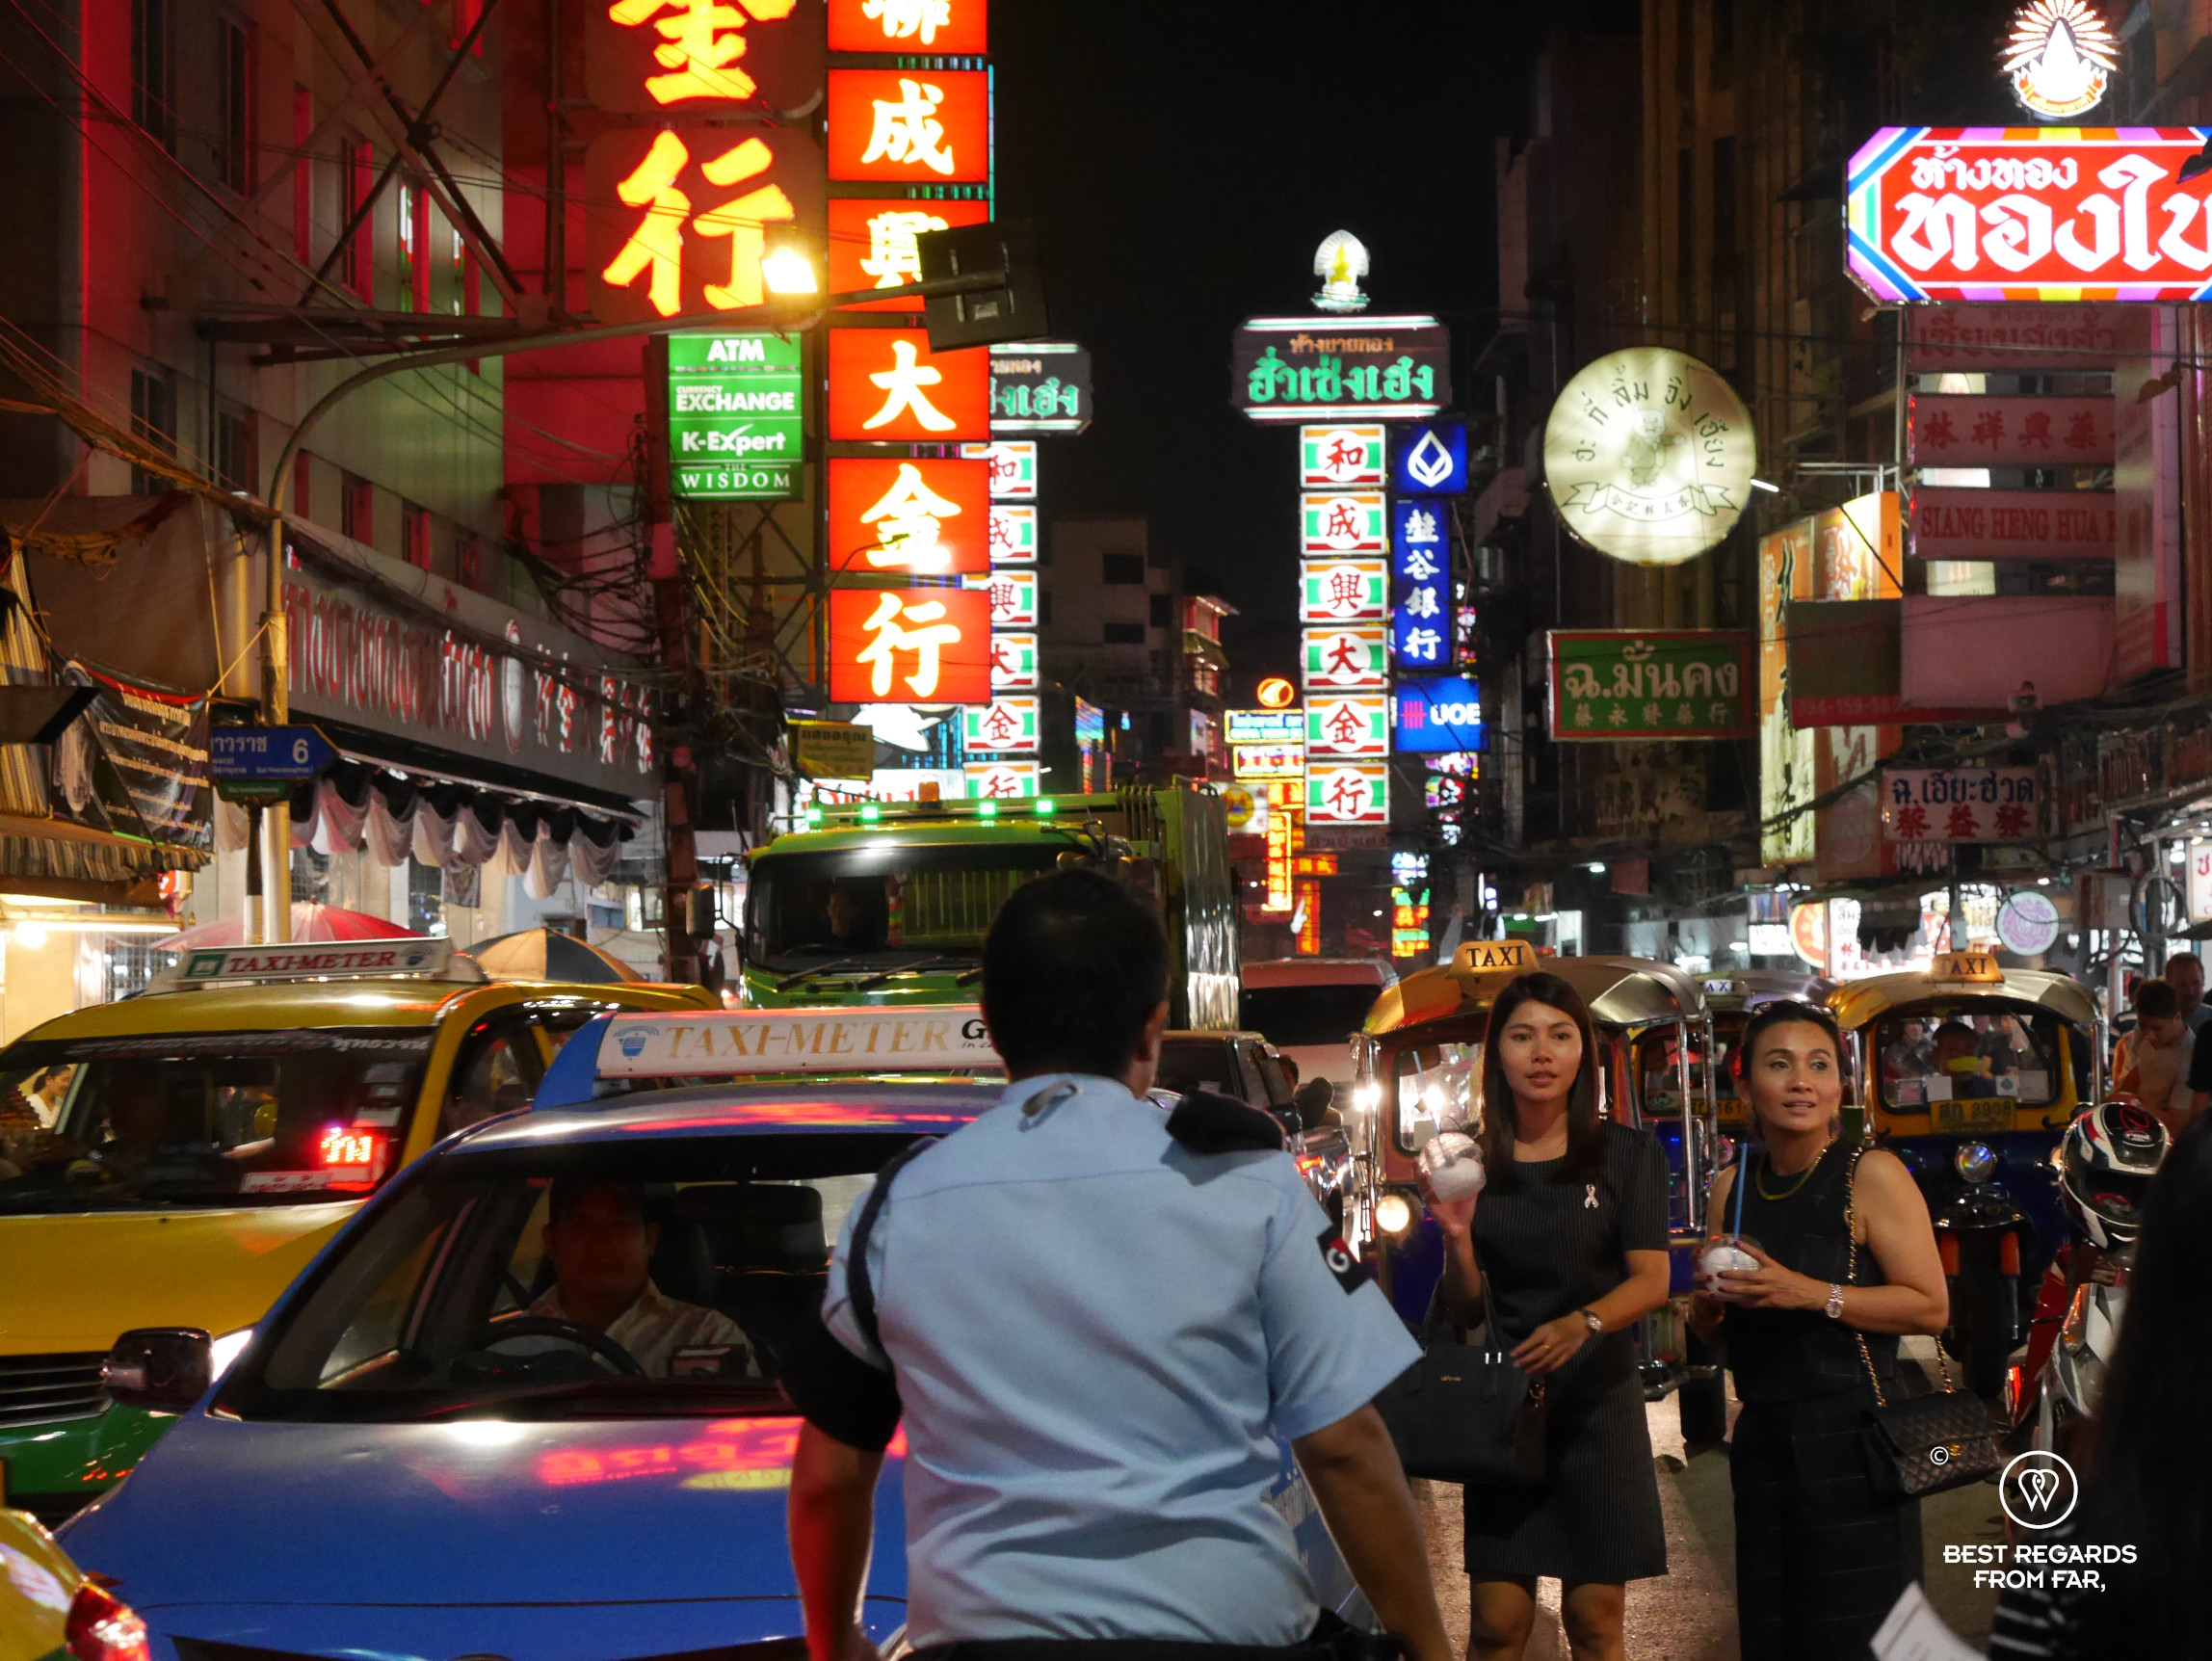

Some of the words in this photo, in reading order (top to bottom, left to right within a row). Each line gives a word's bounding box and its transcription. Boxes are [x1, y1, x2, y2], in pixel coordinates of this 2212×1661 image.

[1910, 145, 2078, 191] ห้างทอง
[707, 339, 765, 362] ATM
[1249, 346, 1435, 402] ฮั่วเซ่งเฮง
[675, 391, 795, 411] EXCHANGE
[681, 424, 786, 457] K-Expert
[680, 472, 791, 489] WISDOM
[1920, 506, 1985, 540] SIANG
[1990, 507, 2050, 541] HENG
[2056, 508, 2100, 542] HUA
[1403, 509, 1442, 661] 盤谷銀行
[1324, 437, 1368, 816] 和成興大金行
[292, 737, 309, 764] 6
[228, 950, 397, 974] TAXI-METER
[1465, 945, 1525, 968] TAXI
[665, 1018, 954, 1060] TAXI-METER
